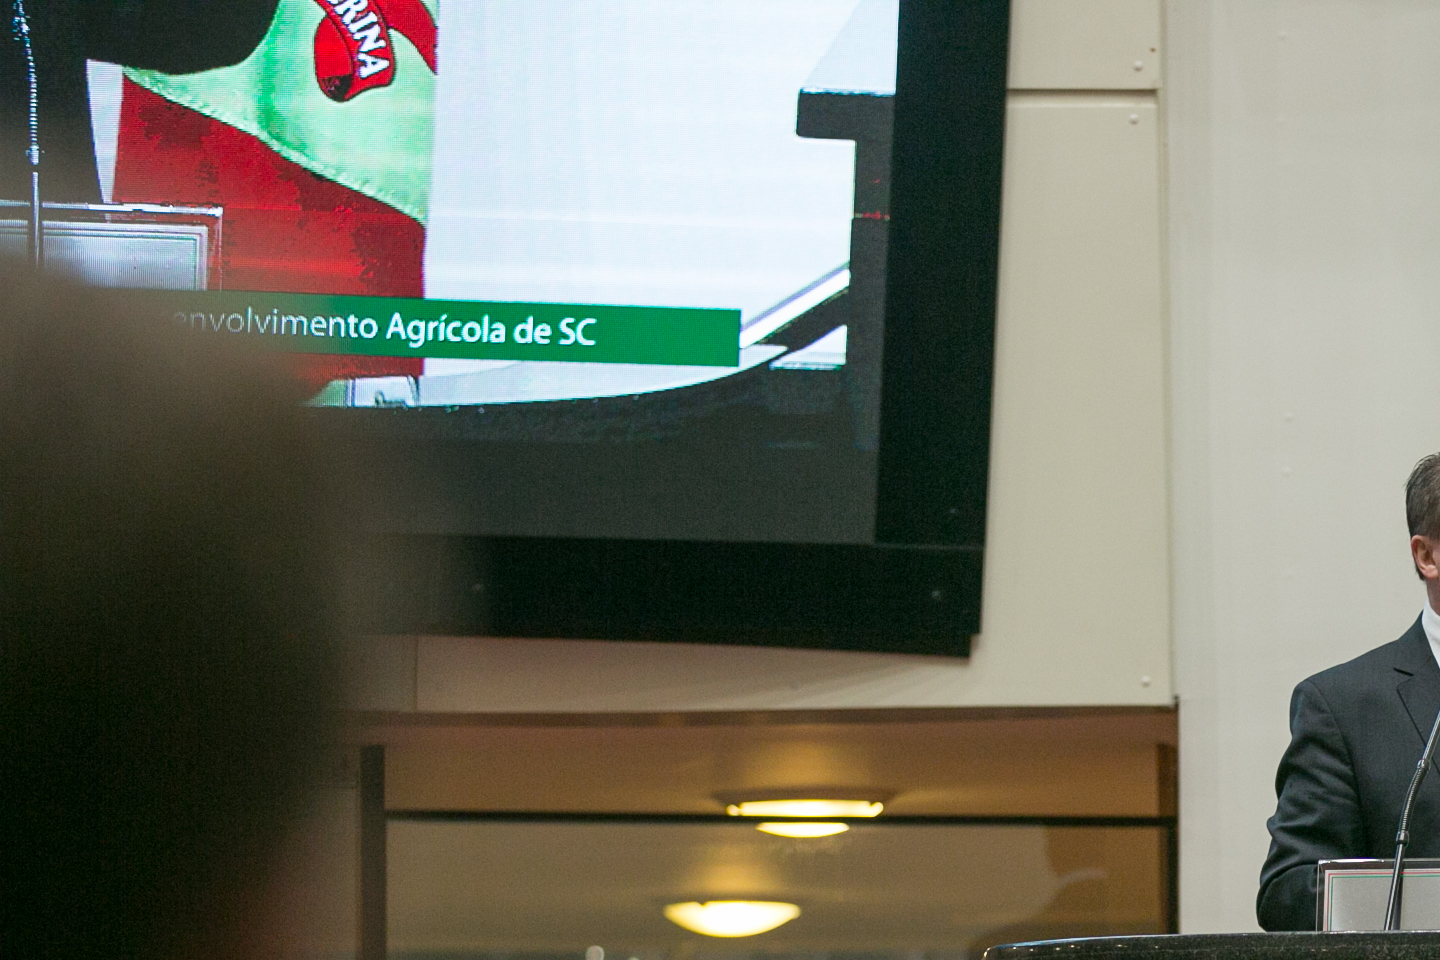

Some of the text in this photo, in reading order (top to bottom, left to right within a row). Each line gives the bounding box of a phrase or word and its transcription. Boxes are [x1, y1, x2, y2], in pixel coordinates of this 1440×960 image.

[327, 0, 390, 79] RINA
[173, 306, 598, 348] envolvimento Agrícola de SC
